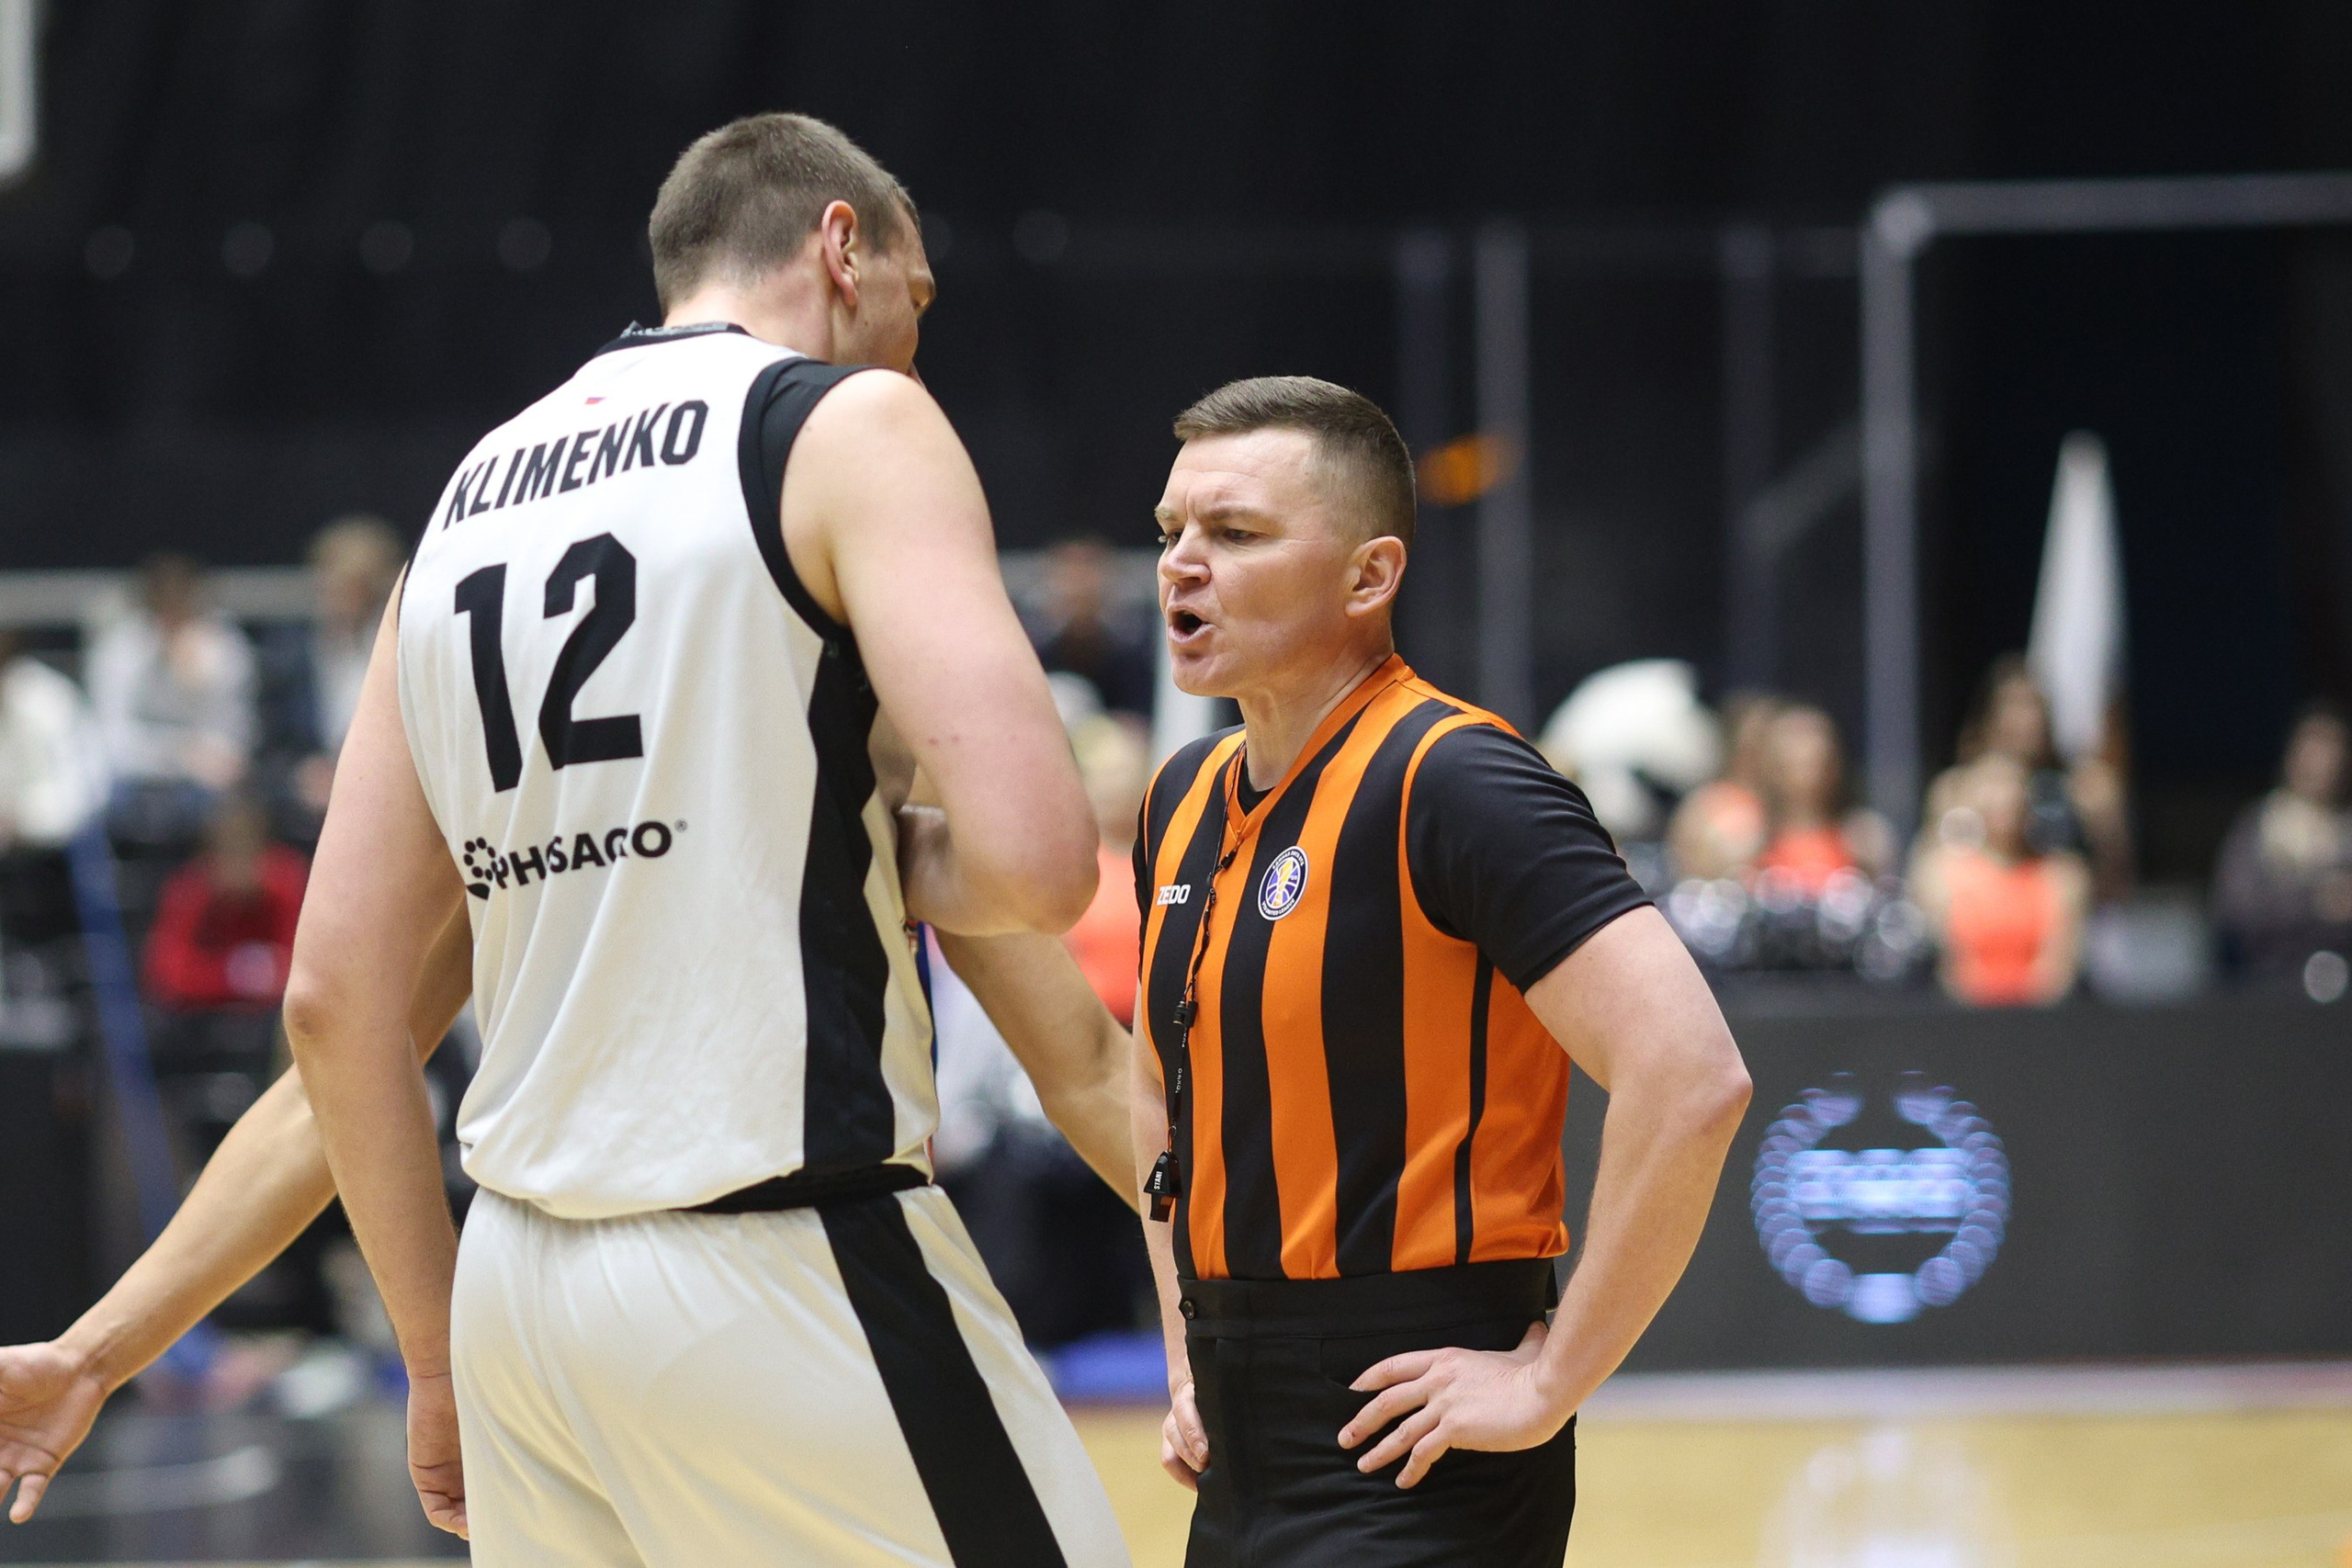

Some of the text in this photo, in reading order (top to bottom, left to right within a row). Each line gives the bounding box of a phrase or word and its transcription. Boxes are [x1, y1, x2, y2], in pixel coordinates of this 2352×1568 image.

[443, 400, 709, 532] KLIMENKO
[454, 532, 643, 793] 12
[1157, 885, 1191, 906] ZEDO
[1153, 1170, 1163, 1190] STANI
